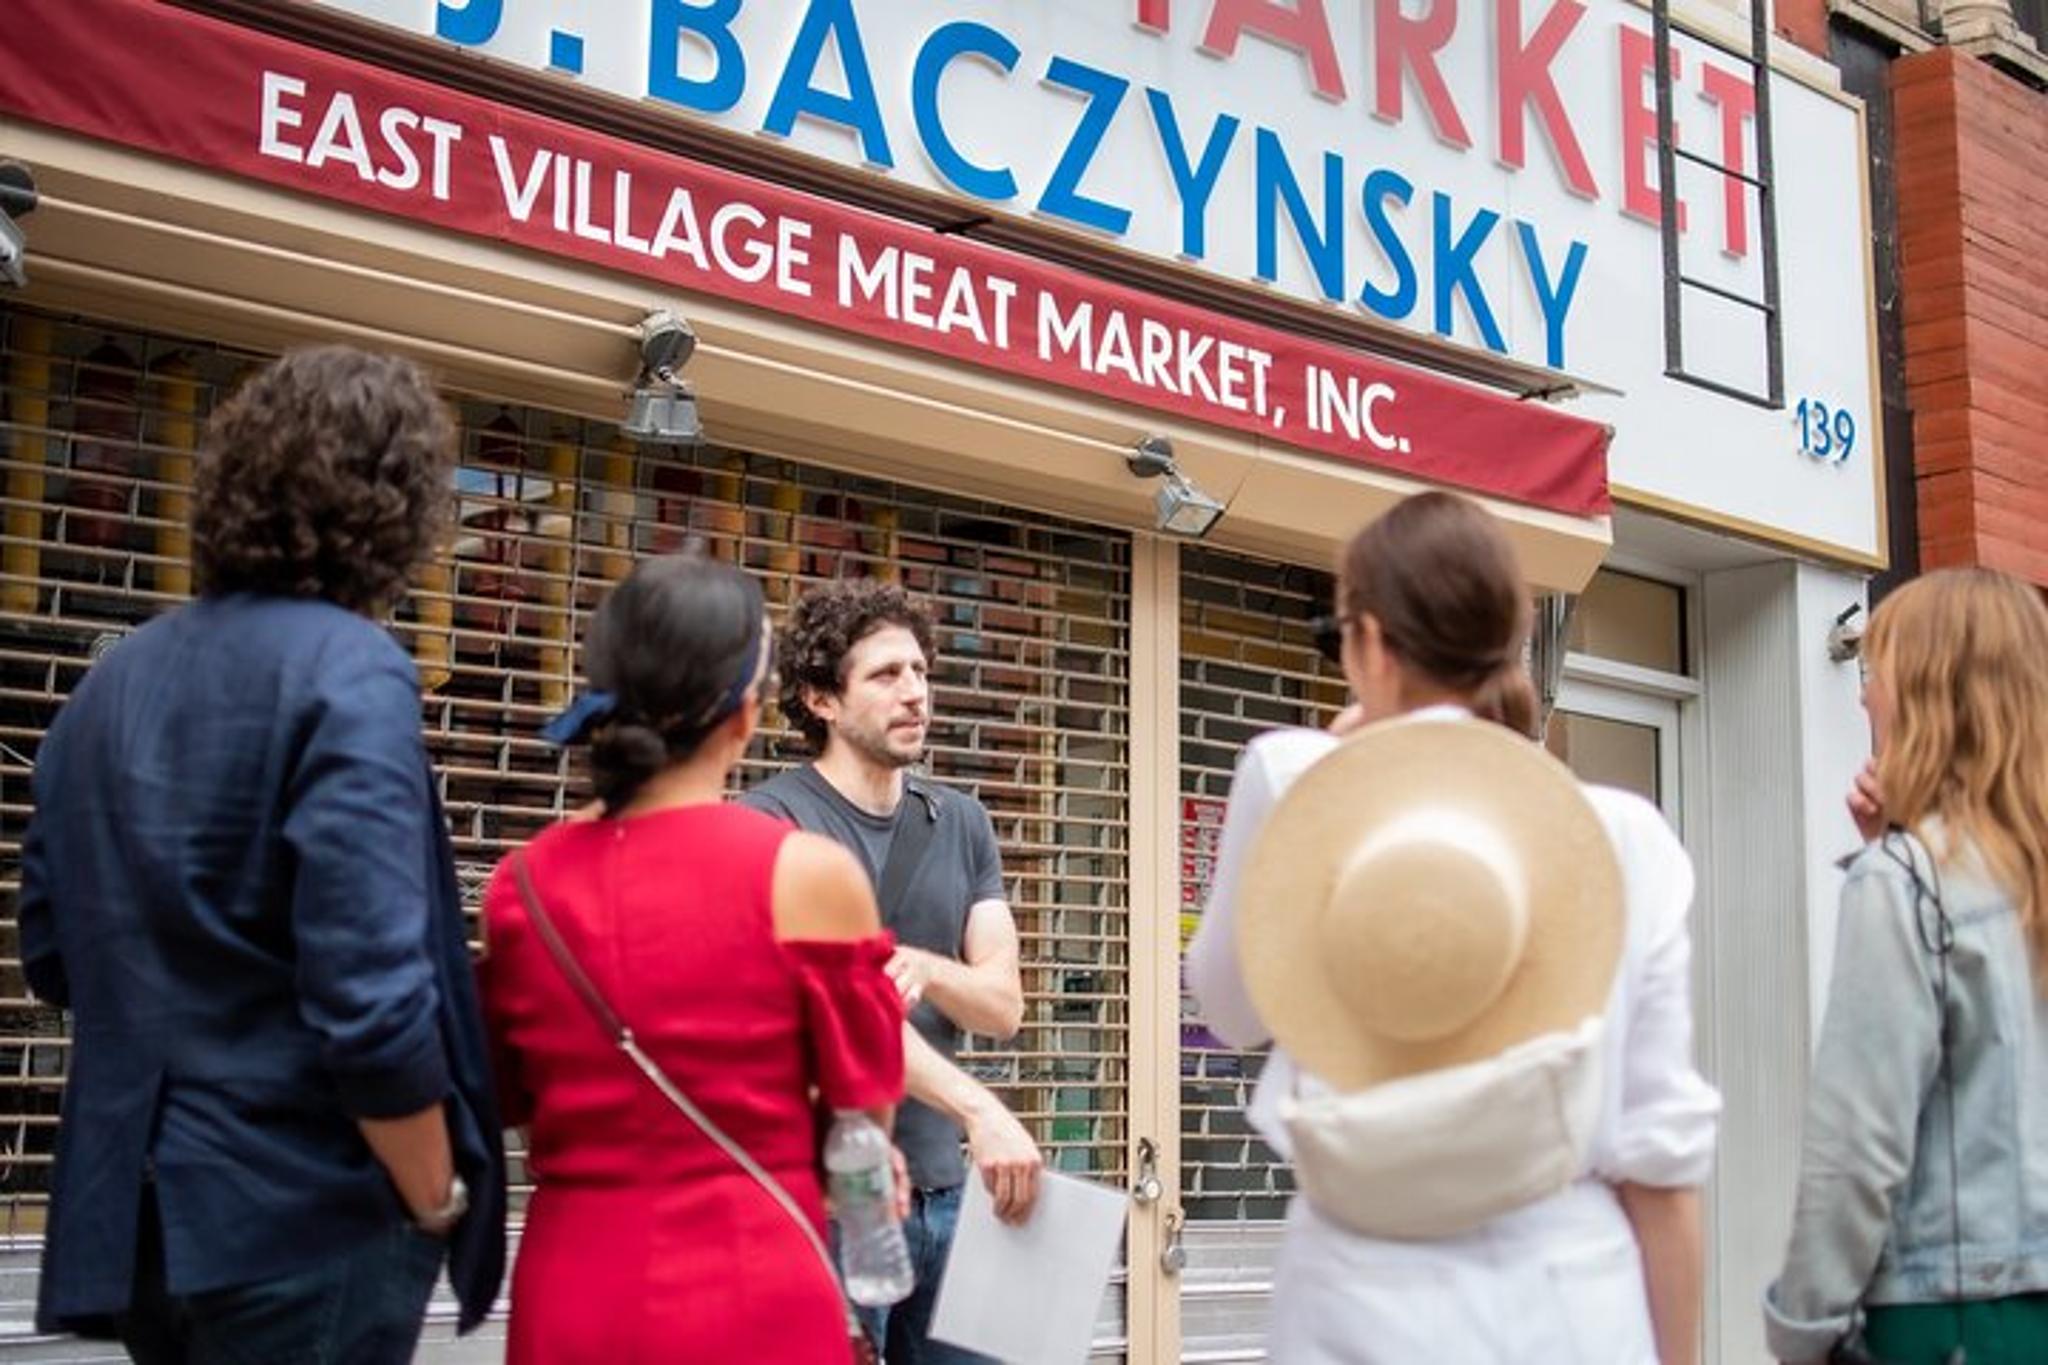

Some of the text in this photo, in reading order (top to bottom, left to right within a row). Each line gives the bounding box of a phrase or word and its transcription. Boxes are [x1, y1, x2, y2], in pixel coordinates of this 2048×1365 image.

[260, 71, 1411, 453] EAST VILLAGE MEAT MARKET, INC.
[647, 0, 1588, 368] BACZYNSKY
[1137, 0, 1757, 257] ARKET
[1797, 398, 1855, 460] 139
